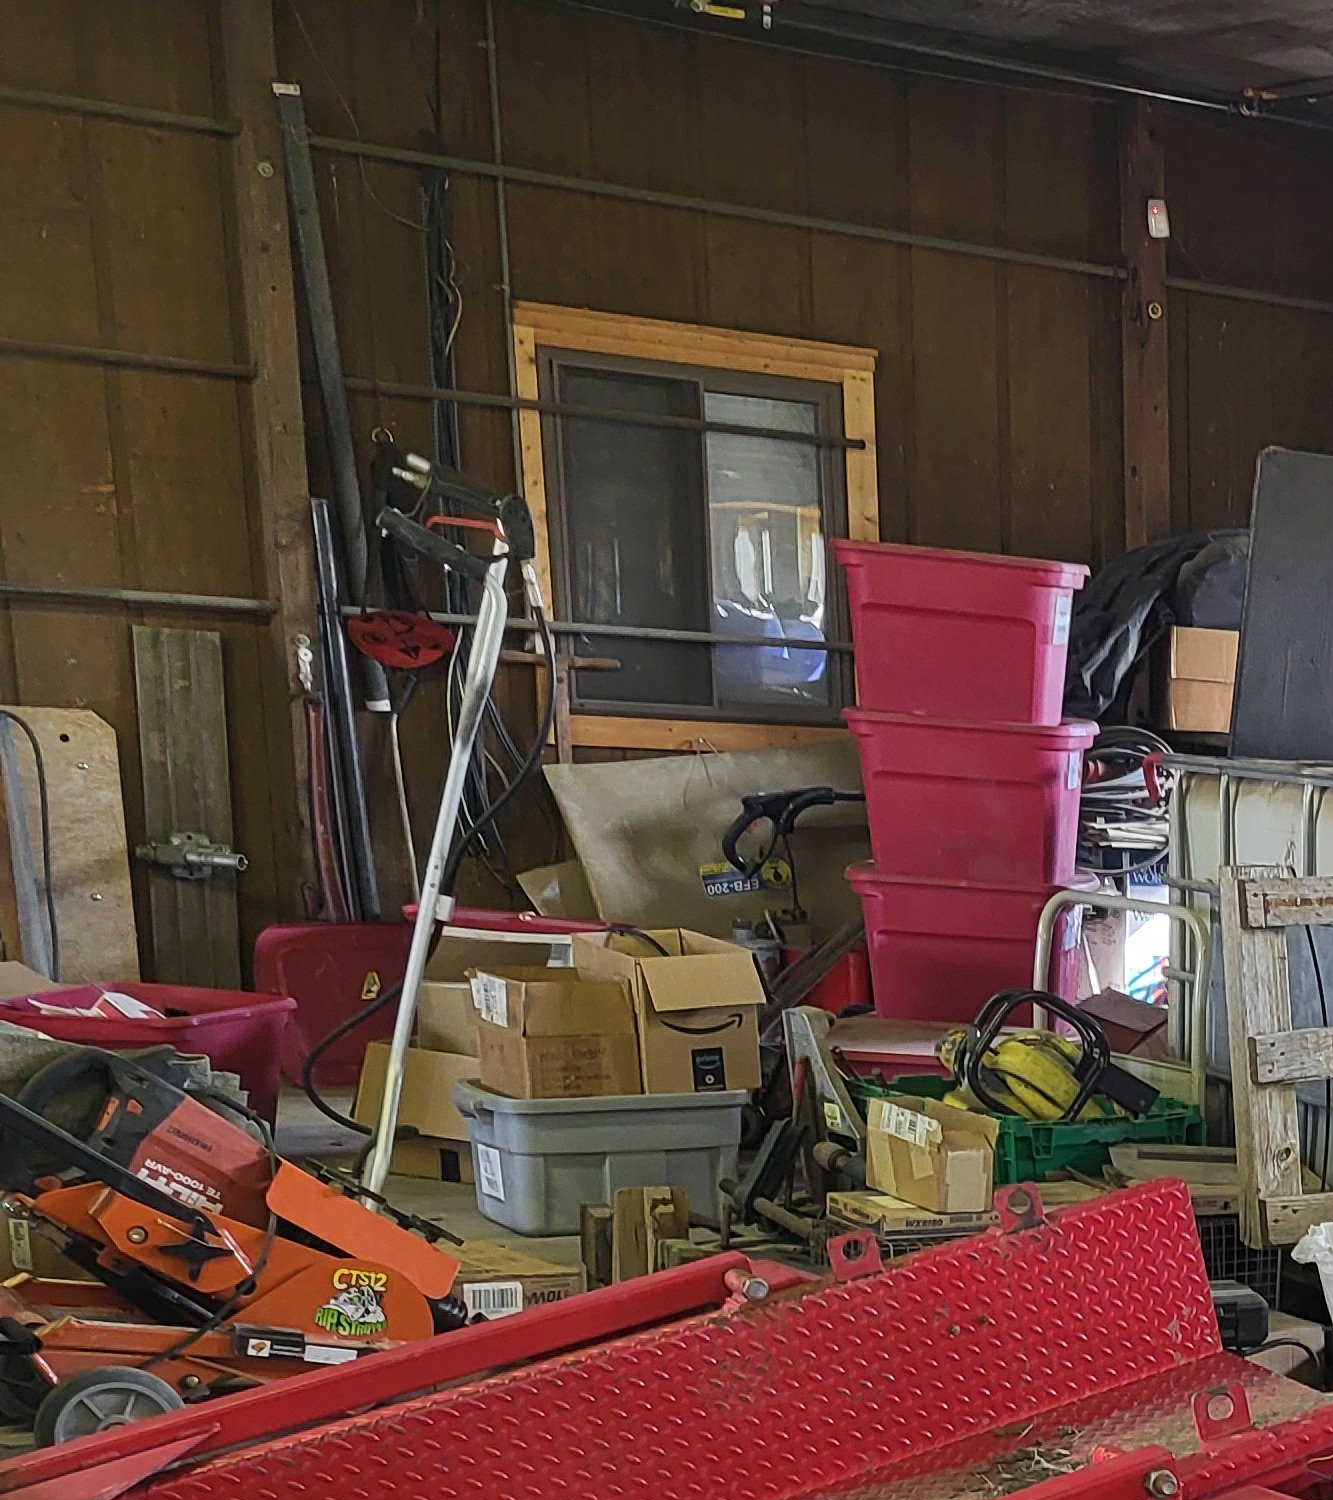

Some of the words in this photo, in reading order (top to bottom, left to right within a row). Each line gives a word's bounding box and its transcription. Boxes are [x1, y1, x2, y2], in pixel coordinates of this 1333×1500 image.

[707, 880, 759, 896] EFB-200
[145, 1158, 206, 1191] 1000-AVR
[333, 1268, 388, 1291] CTS12
